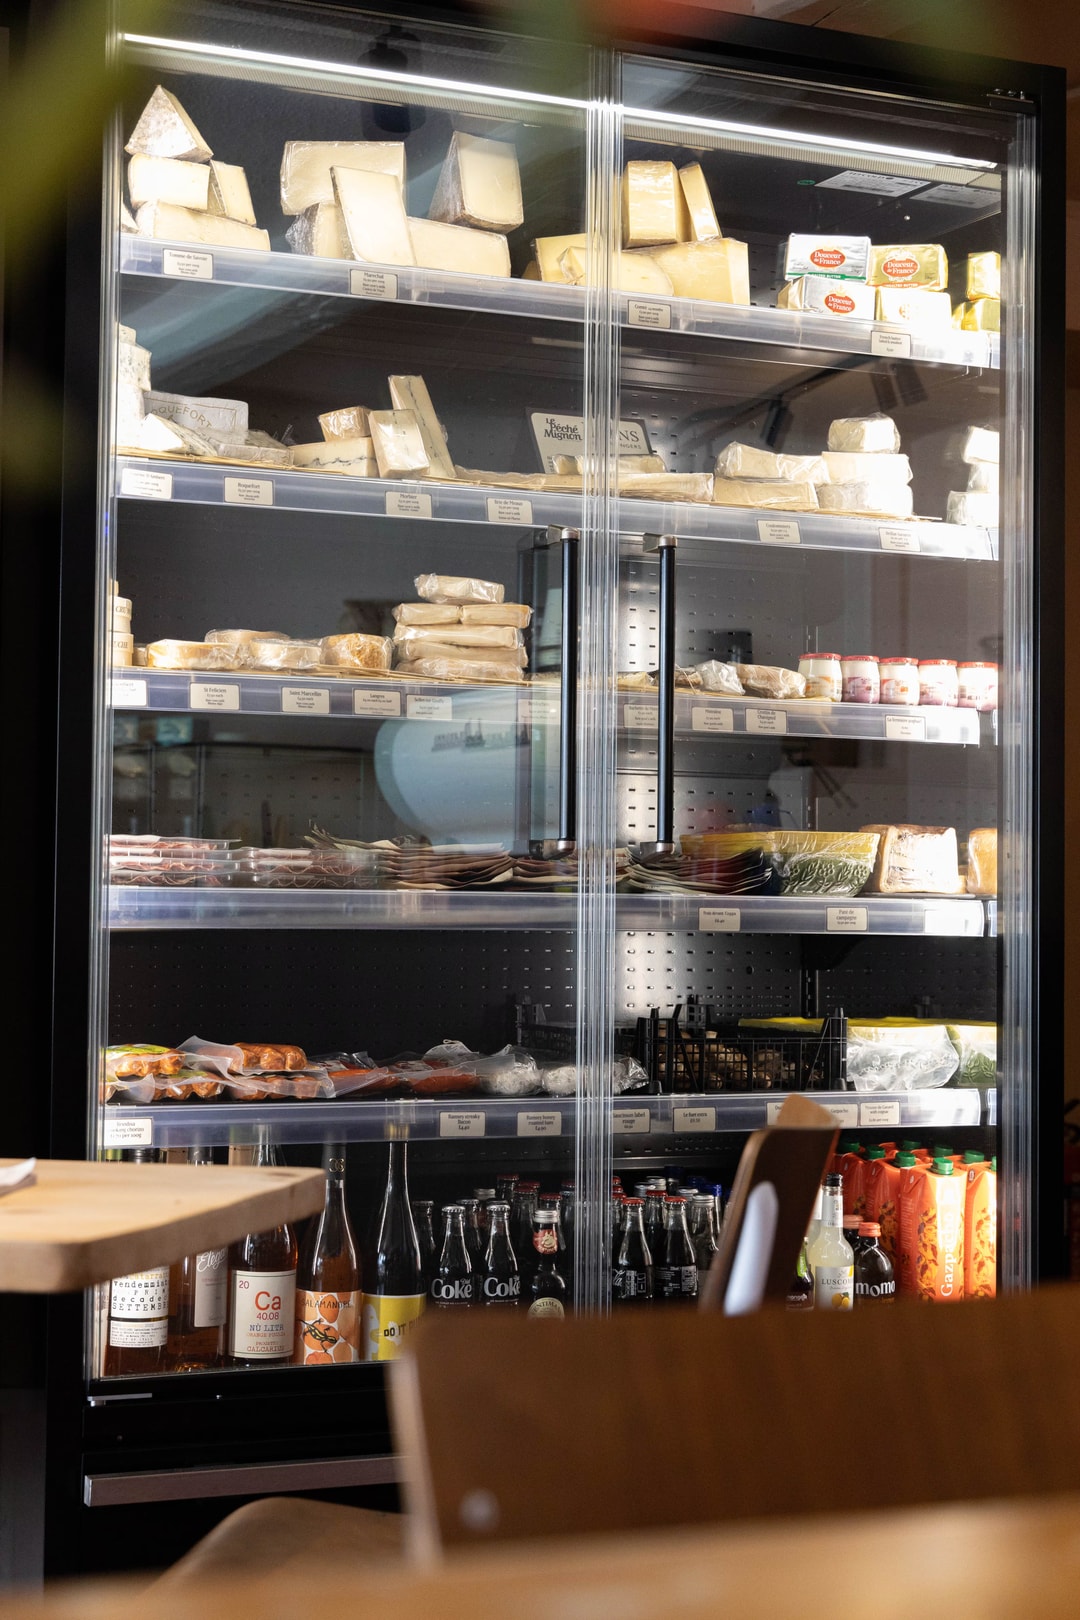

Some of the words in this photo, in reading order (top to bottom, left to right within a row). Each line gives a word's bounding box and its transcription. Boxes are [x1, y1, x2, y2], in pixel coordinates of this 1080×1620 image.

[814, 251, 843, 260] Douceur
[819, 257, 843, 266] France
[888, 261, 916, 271] Douceur
[893, 268, 915, 276] France
[828, 295, 855, 306] Douceur
[833, 302, 855, 312] France
[550, 420, 580, 434] Péché
[544, 428, 583, 441] Mignon
[238, 482, 261, 490] Roquefort
[239, 1280, 250, 1290] 20
[431, 1278, 472, 1299] Coke
[856, 1280, 896, 1297] momo
[255, 1291, 281, 1311] Ca
[256, 1312, 280, 1321] 40.08
[383, 1327, 396, 1337] DO
